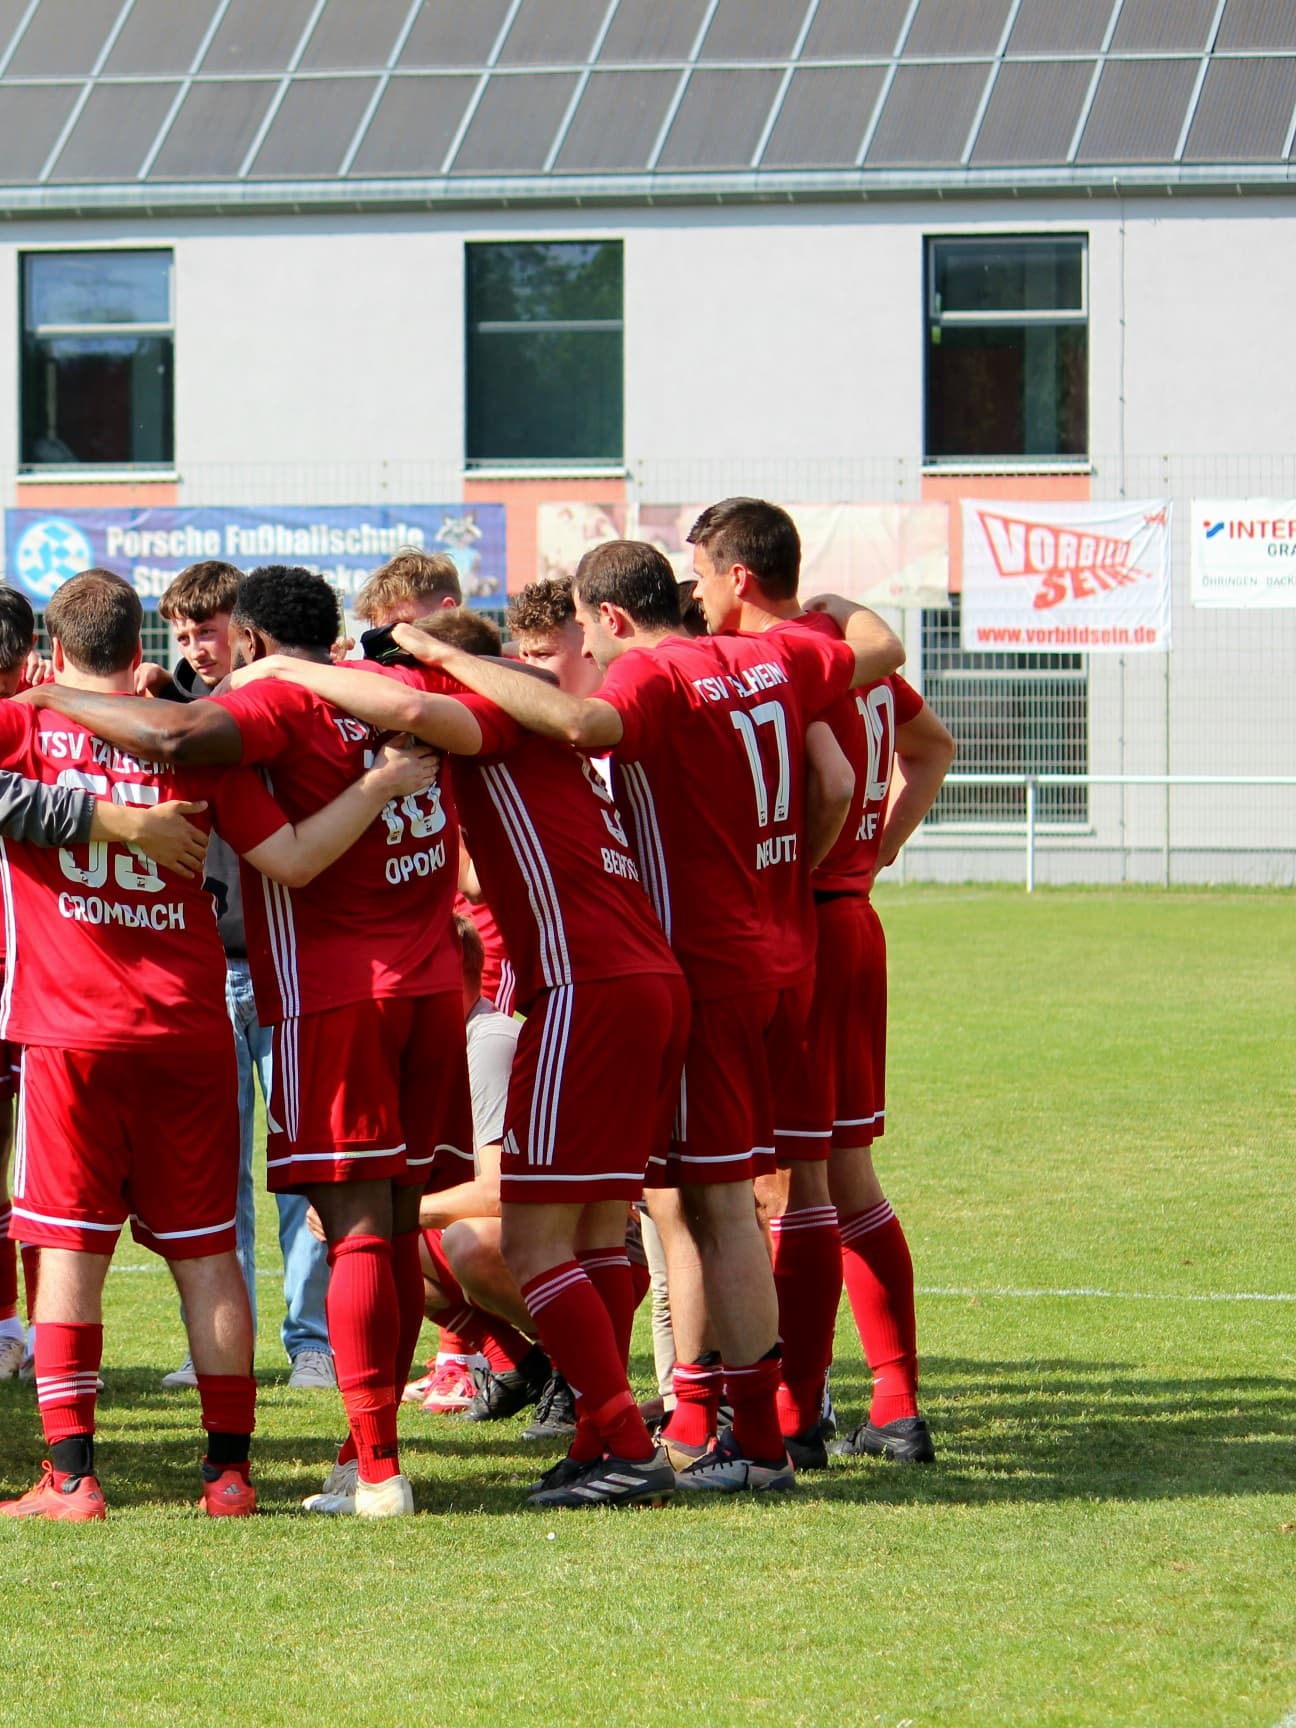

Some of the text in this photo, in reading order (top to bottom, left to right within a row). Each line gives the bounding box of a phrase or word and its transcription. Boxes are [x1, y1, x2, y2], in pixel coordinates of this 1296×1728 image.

[106, 525, 221, 557] Porsche
[976, 625, 1157, 645] www.vorbildsein.de
[38, 731, 86, 760] TSV
[730, 701, 790, 827] 17
[58, 891, 185, 930] CROMBACH
